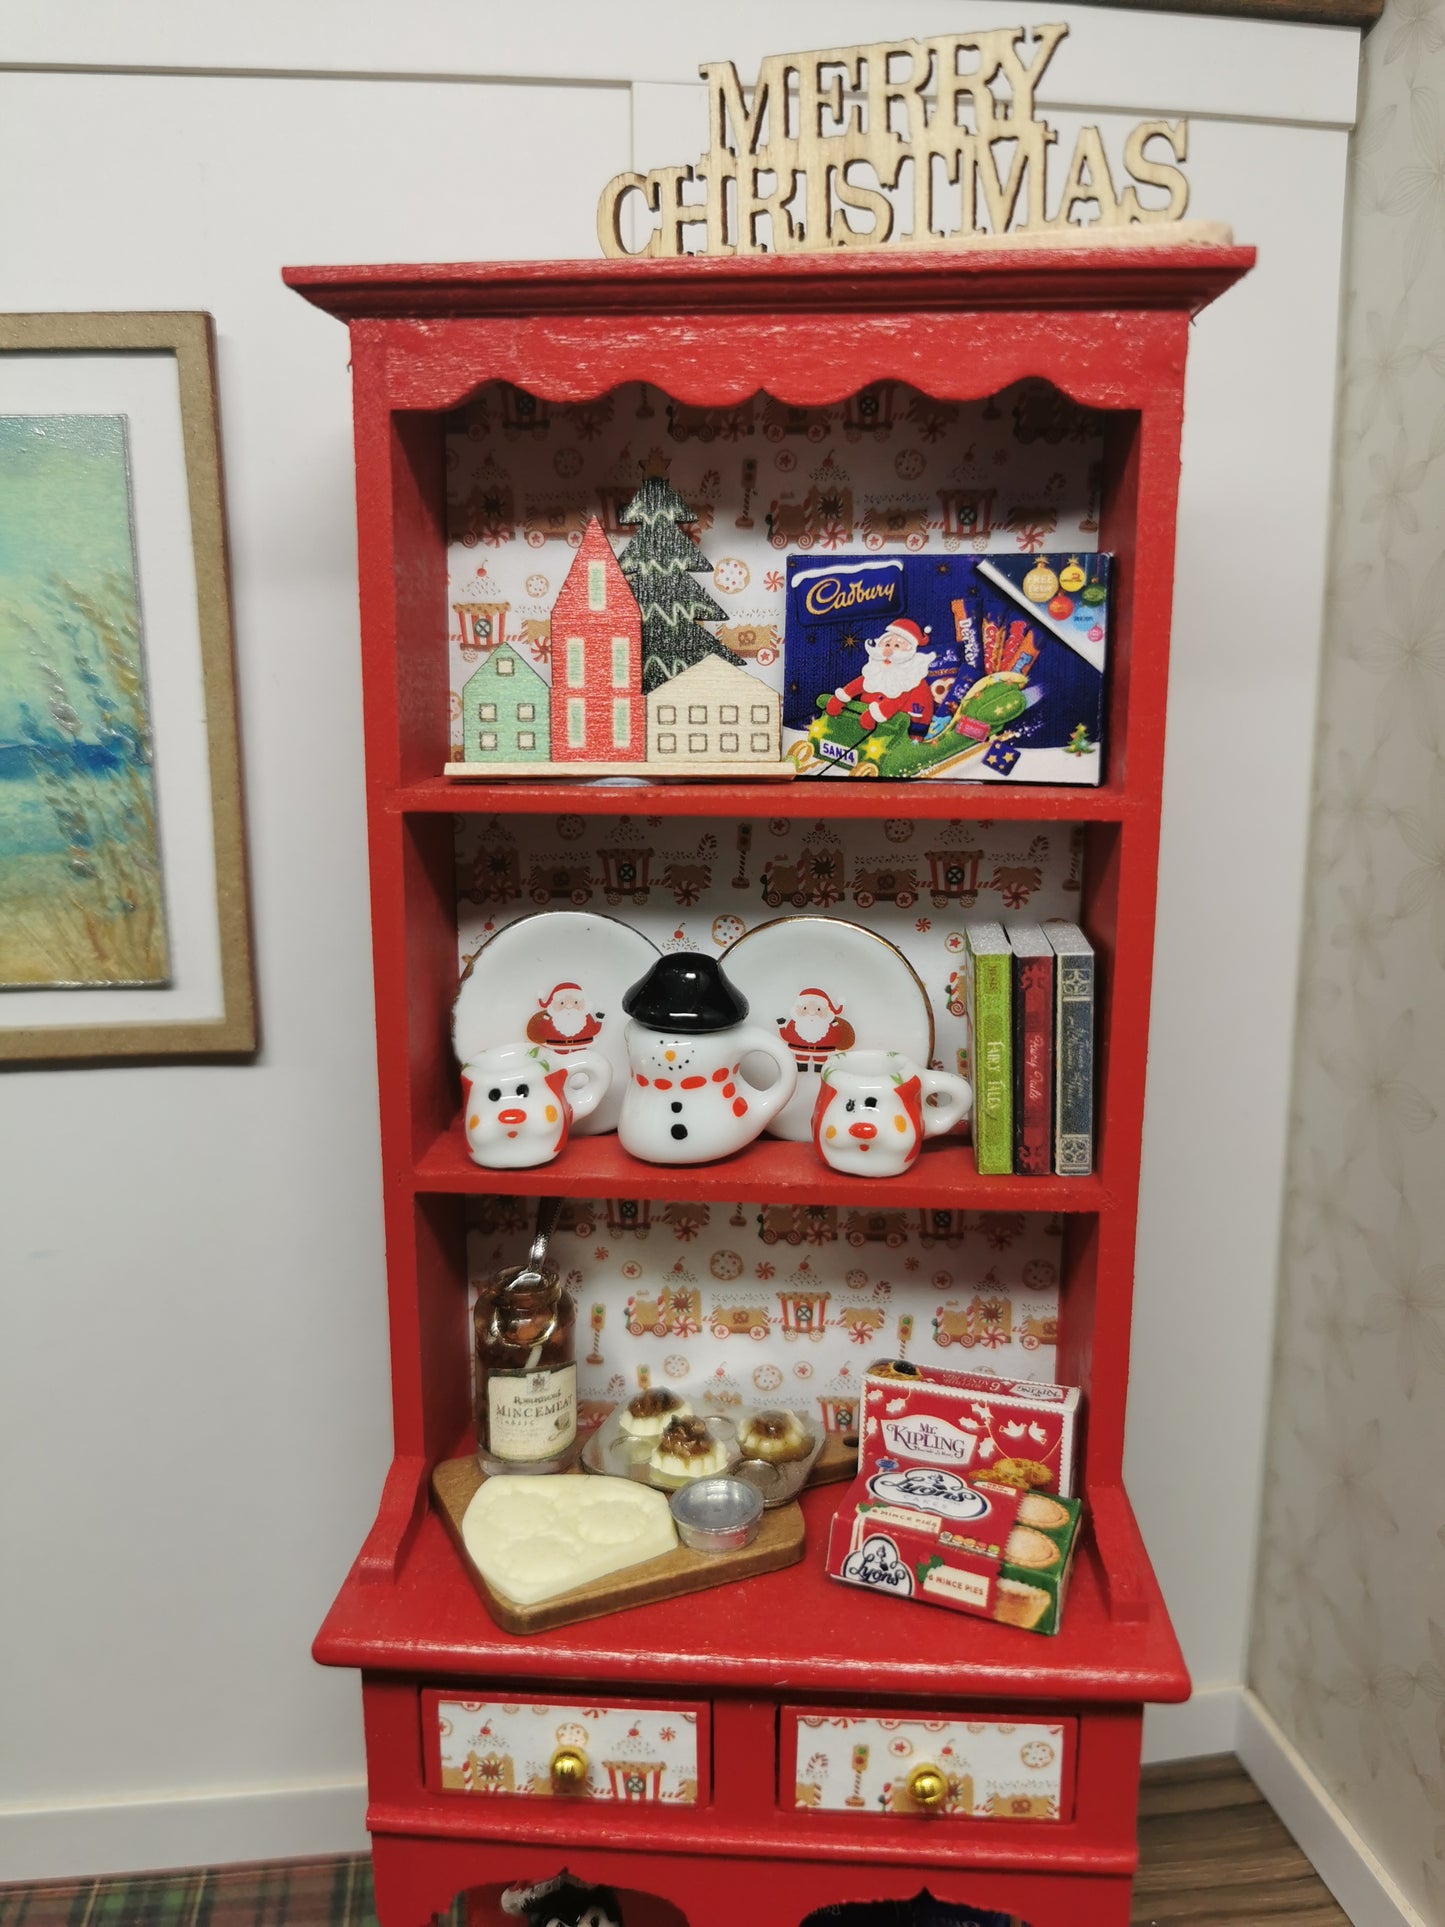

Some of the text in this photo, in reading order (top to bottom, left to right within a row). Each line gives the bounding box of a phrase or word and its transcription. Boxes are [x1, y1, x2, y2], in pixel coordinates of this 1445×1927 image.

[699, 23, 1069, 161] MERRY
[597, 118, 1189, 259] CHRISTMAS
[806, 578, 896, 615] Cadbury
[497, 1394, 573, 1418] MINCEMEAT
[886, 1423, 965, 1458] KIPLING
[880, 1475, 977, 1503] Lyons
[849, 1553, 906, 1587] Lyons
[935, 1576, 963, 1590] MINCE
[964, 1583, 984, 1596] PIES
